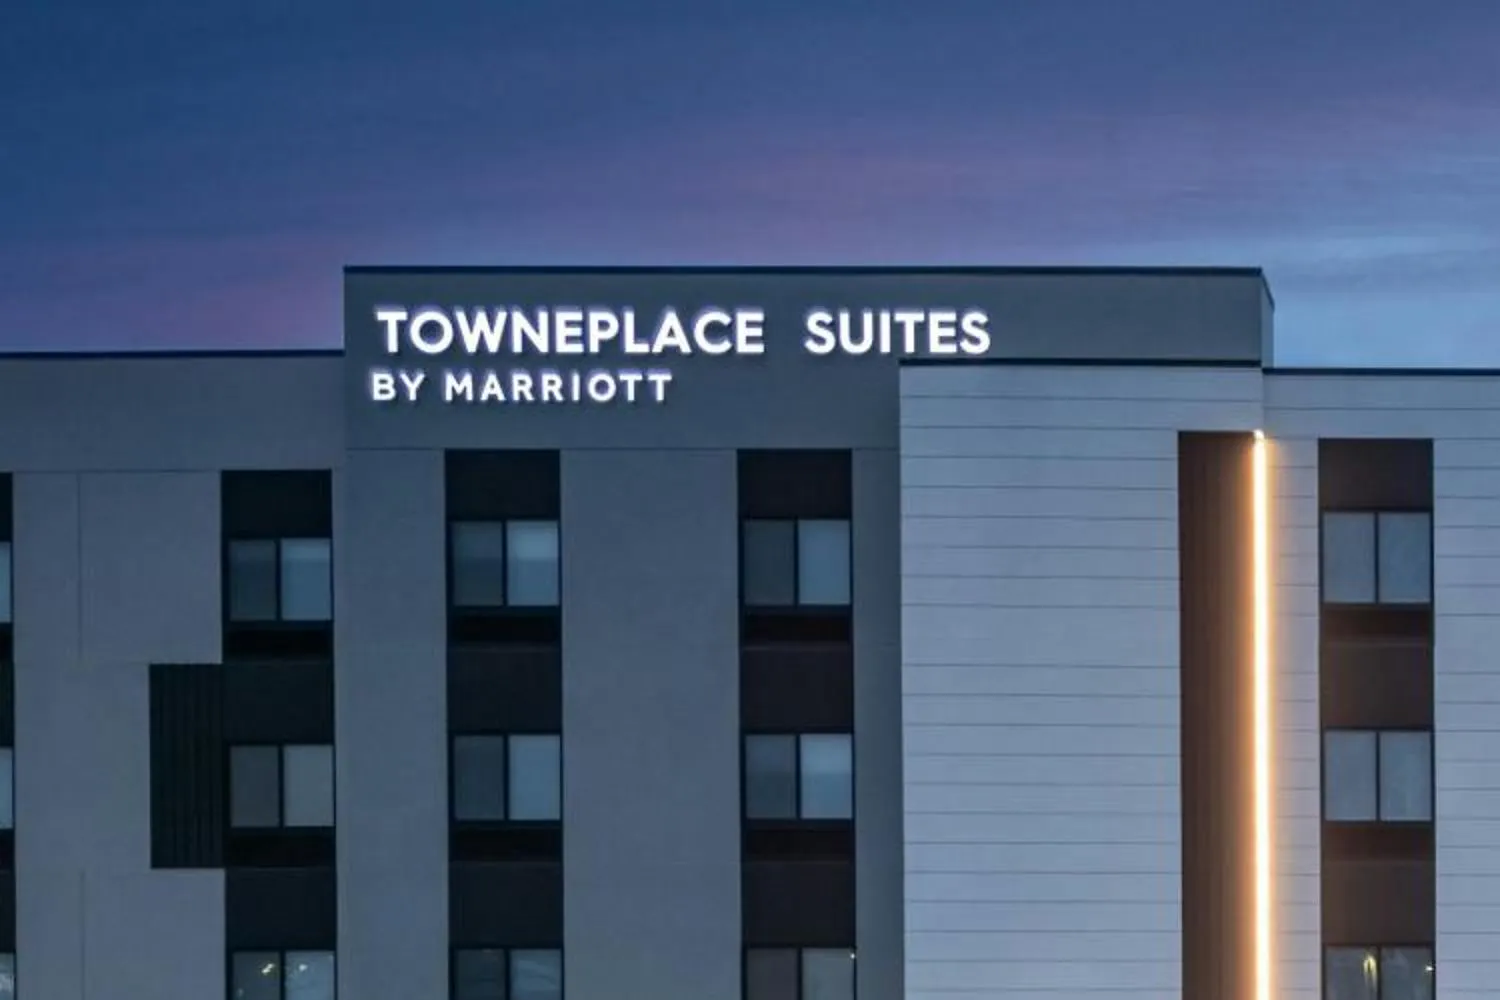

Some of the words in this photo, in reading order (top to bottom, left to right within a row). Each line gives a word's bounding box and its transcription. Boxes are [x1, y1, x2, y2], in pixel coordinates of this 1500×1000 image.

[375, 308, 765, 355] TOWNEPLACE
[804, 309, 991, 355] SUITES
[371, 370, 425, 402] BY
[444, 370, 673, 403] MARRIOTT
